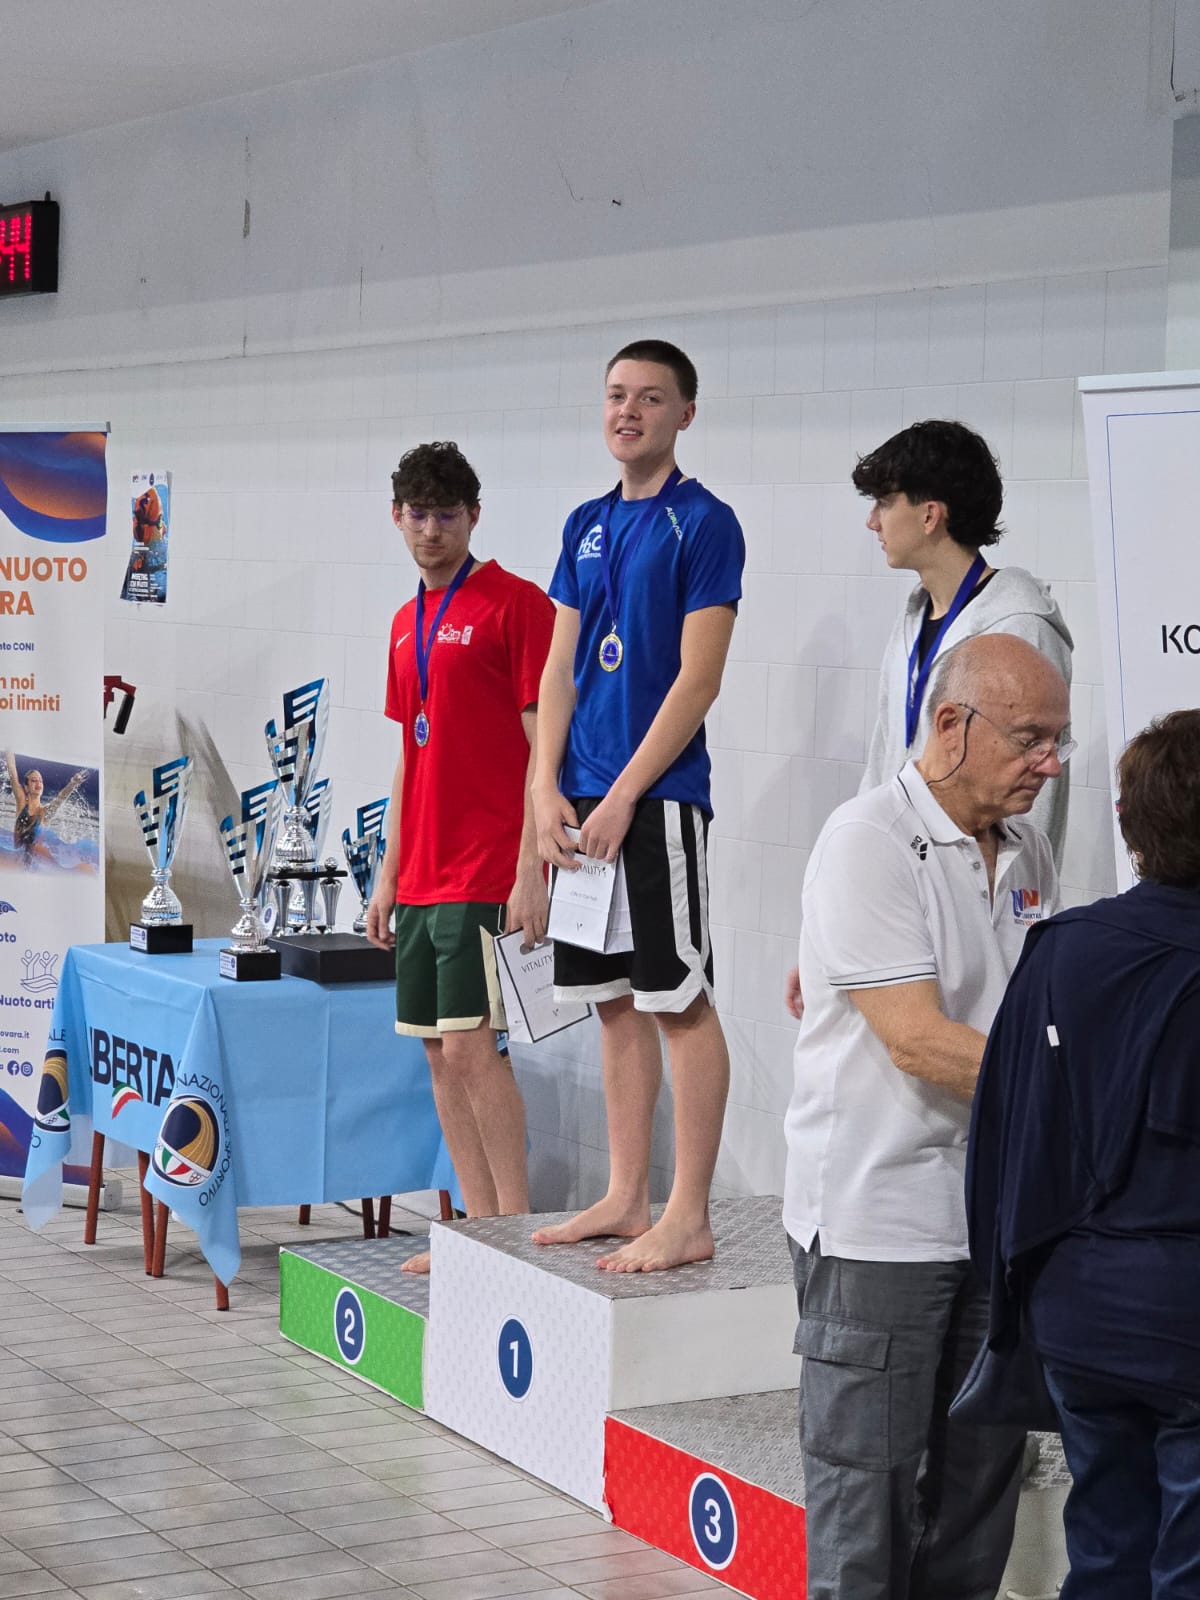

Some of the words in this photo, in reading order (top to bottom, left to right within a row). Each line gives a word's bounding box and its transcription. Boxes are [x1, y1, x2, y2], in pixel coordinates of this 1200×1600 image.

[13, 643, 35, 651] CONI
[10, 673, 35, 690] noi
[16, 694, 60, 711] limiti
[199, 1140, 232, 1206] SPORTIVO
[344, 1307, 356, 1347] 2
[508, 1339, 520, 1379] 1
[703, 1497, 723, 1544] 3
